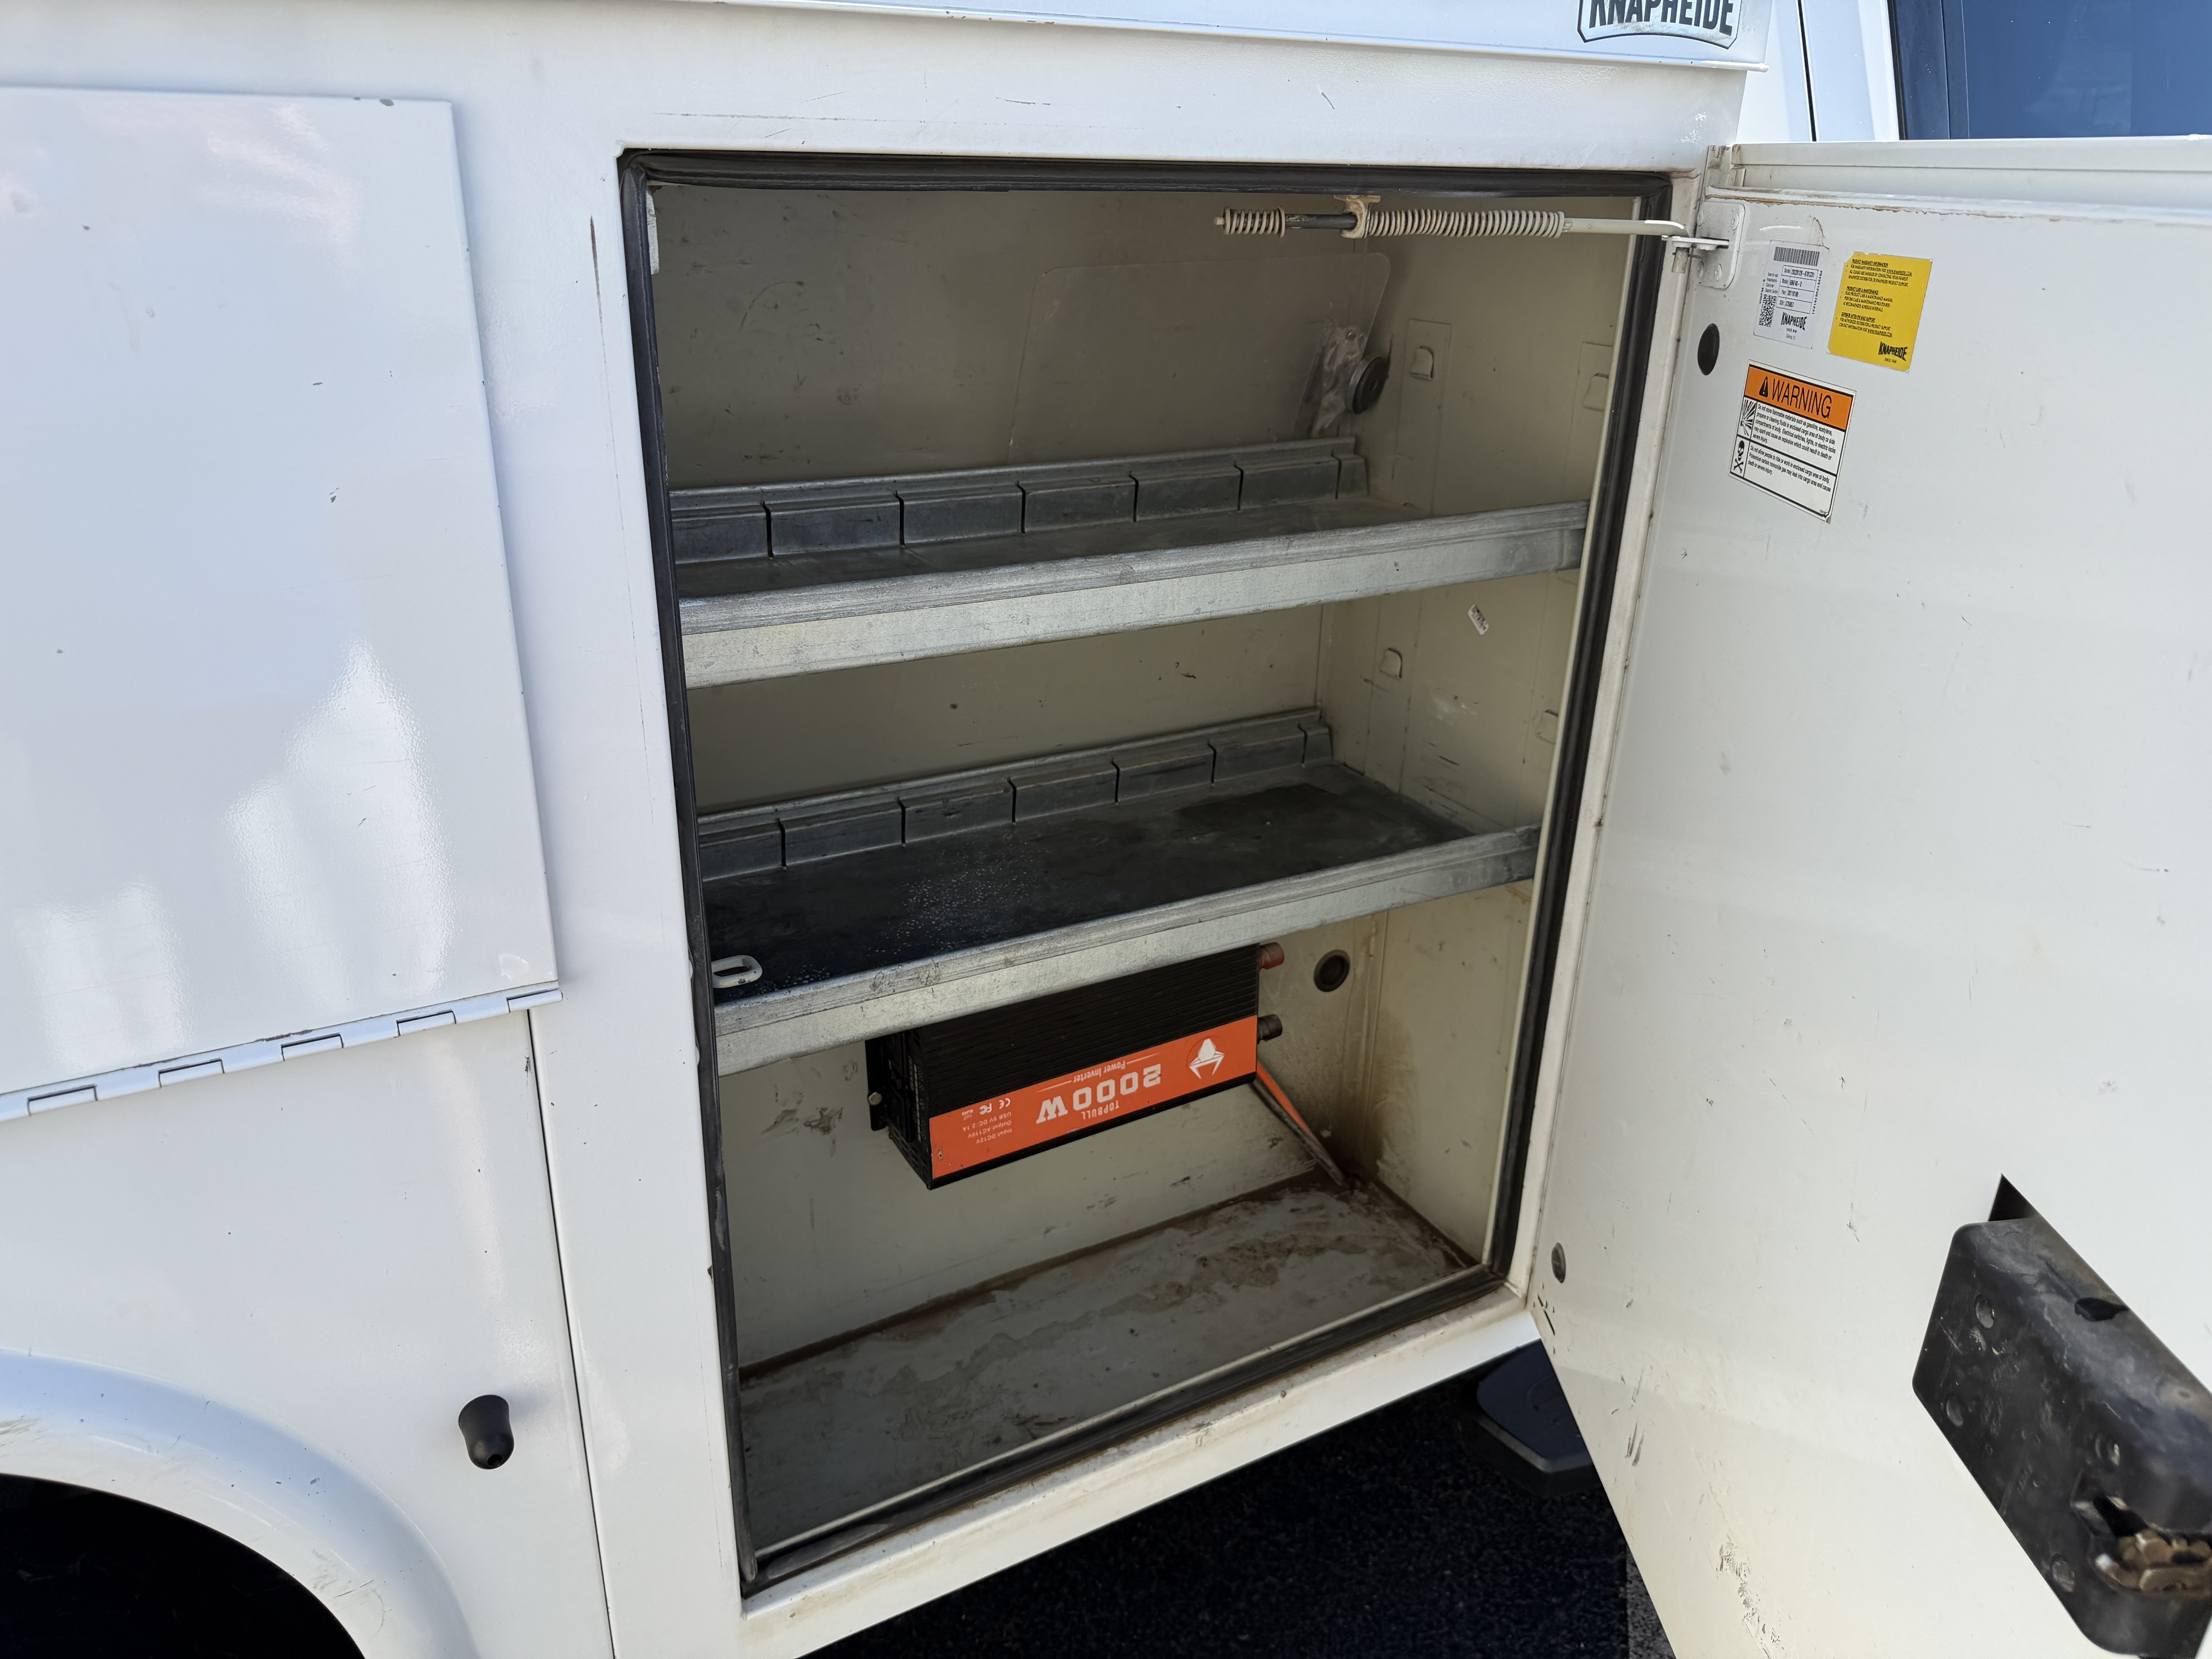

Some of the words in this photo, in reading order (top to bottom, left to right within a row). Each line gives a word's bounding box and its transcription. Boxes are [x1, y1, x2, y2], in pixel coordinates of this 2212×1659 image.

[1589, 0, 1733, 36] KNAPHEIDE
[1781, 312, 1807, 330] KNAPHEIDE
[1878, 341, 1908, 361] KNAPHEIDE
[1772, 379, 1832, 419] WARNING
[1073, 1068, 1101, 1083] Inverter
[1103, 1060, 1125, 1073] Power
[1036, 1063, 1161, 1123] 2000W
[999, 1111, 1011, 1120] USB
[1081, 1100, 1119, 1120] TOPBULL
